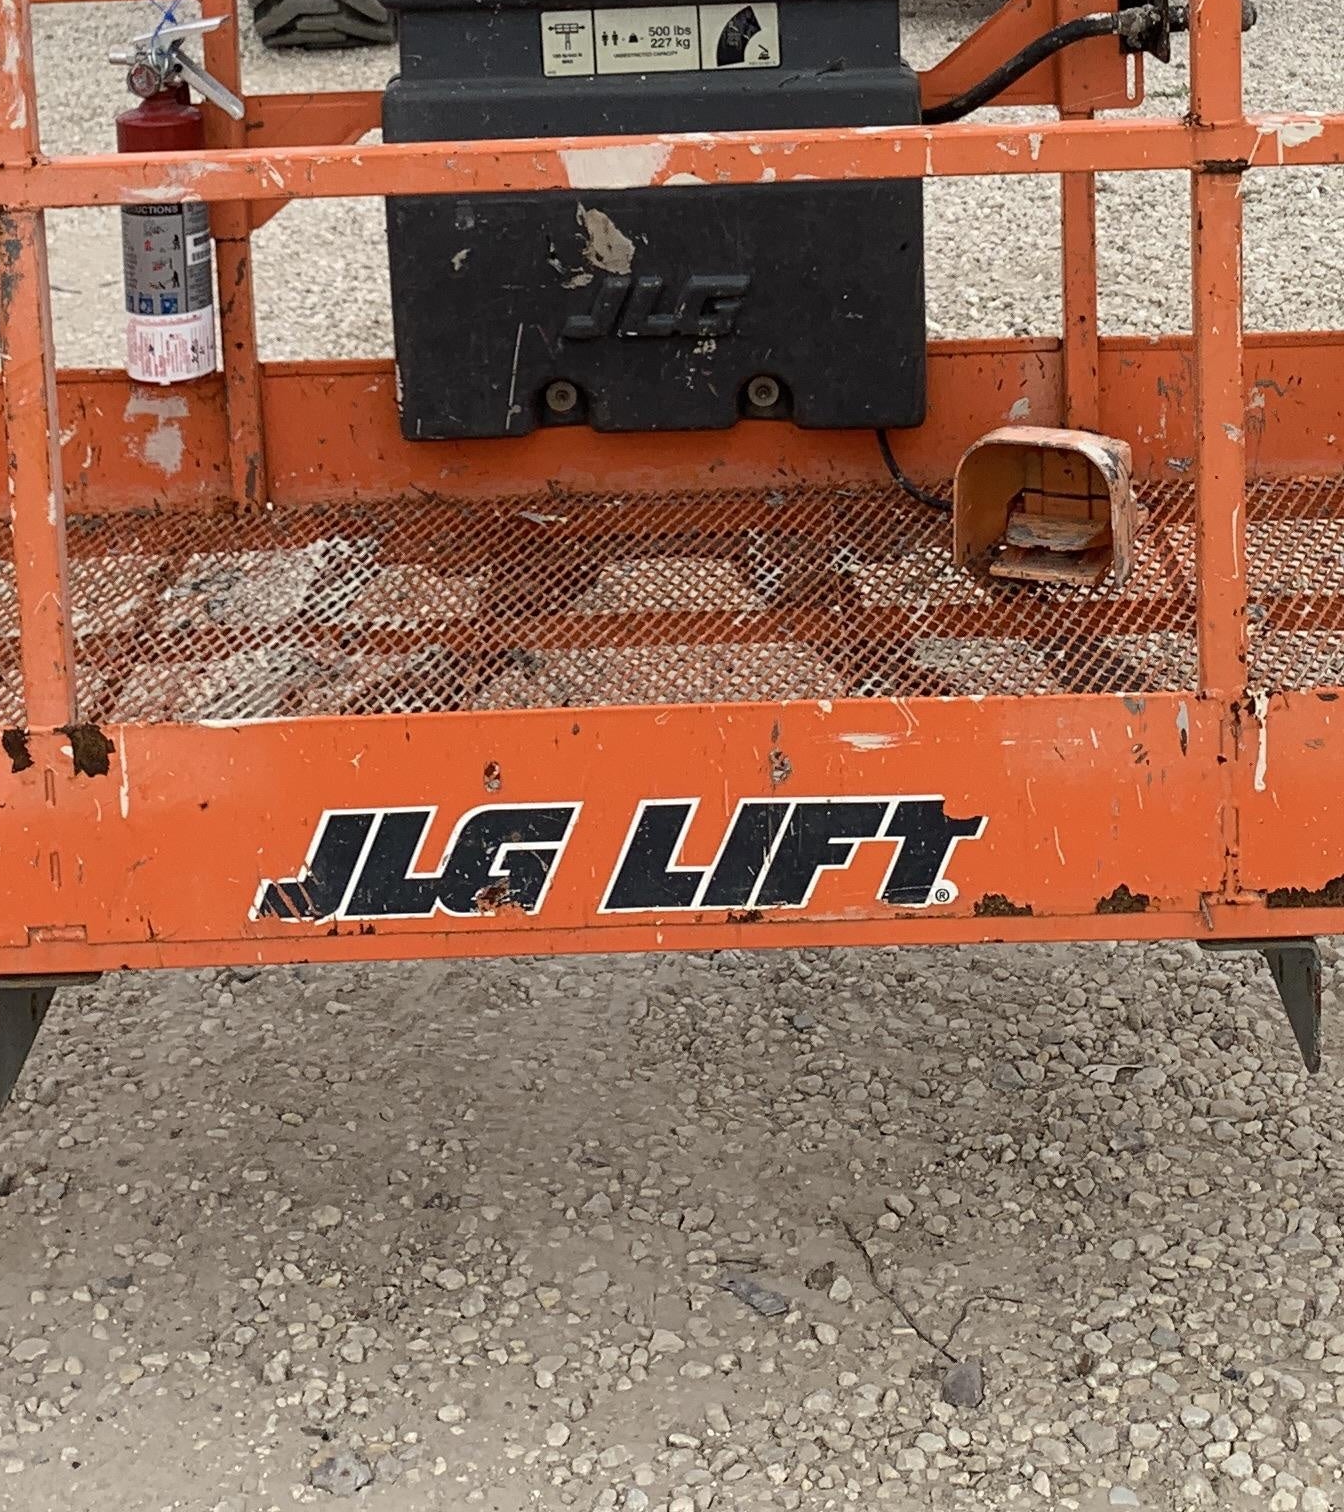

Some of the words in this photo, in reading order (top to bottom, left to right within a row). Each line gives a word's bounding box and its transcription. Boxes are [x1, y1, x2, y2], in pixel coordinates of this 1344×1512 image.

[648, 26, 670, 36] 500
[673, 25, 691, 35] lbs
[651, 38, 671, 48] 227
[676, 37, 690, 49] kg
[562, 274, 751, 340] JLG
[250, 801, 584, 923] JLG
[597, 794, 988, 916] LIFT
